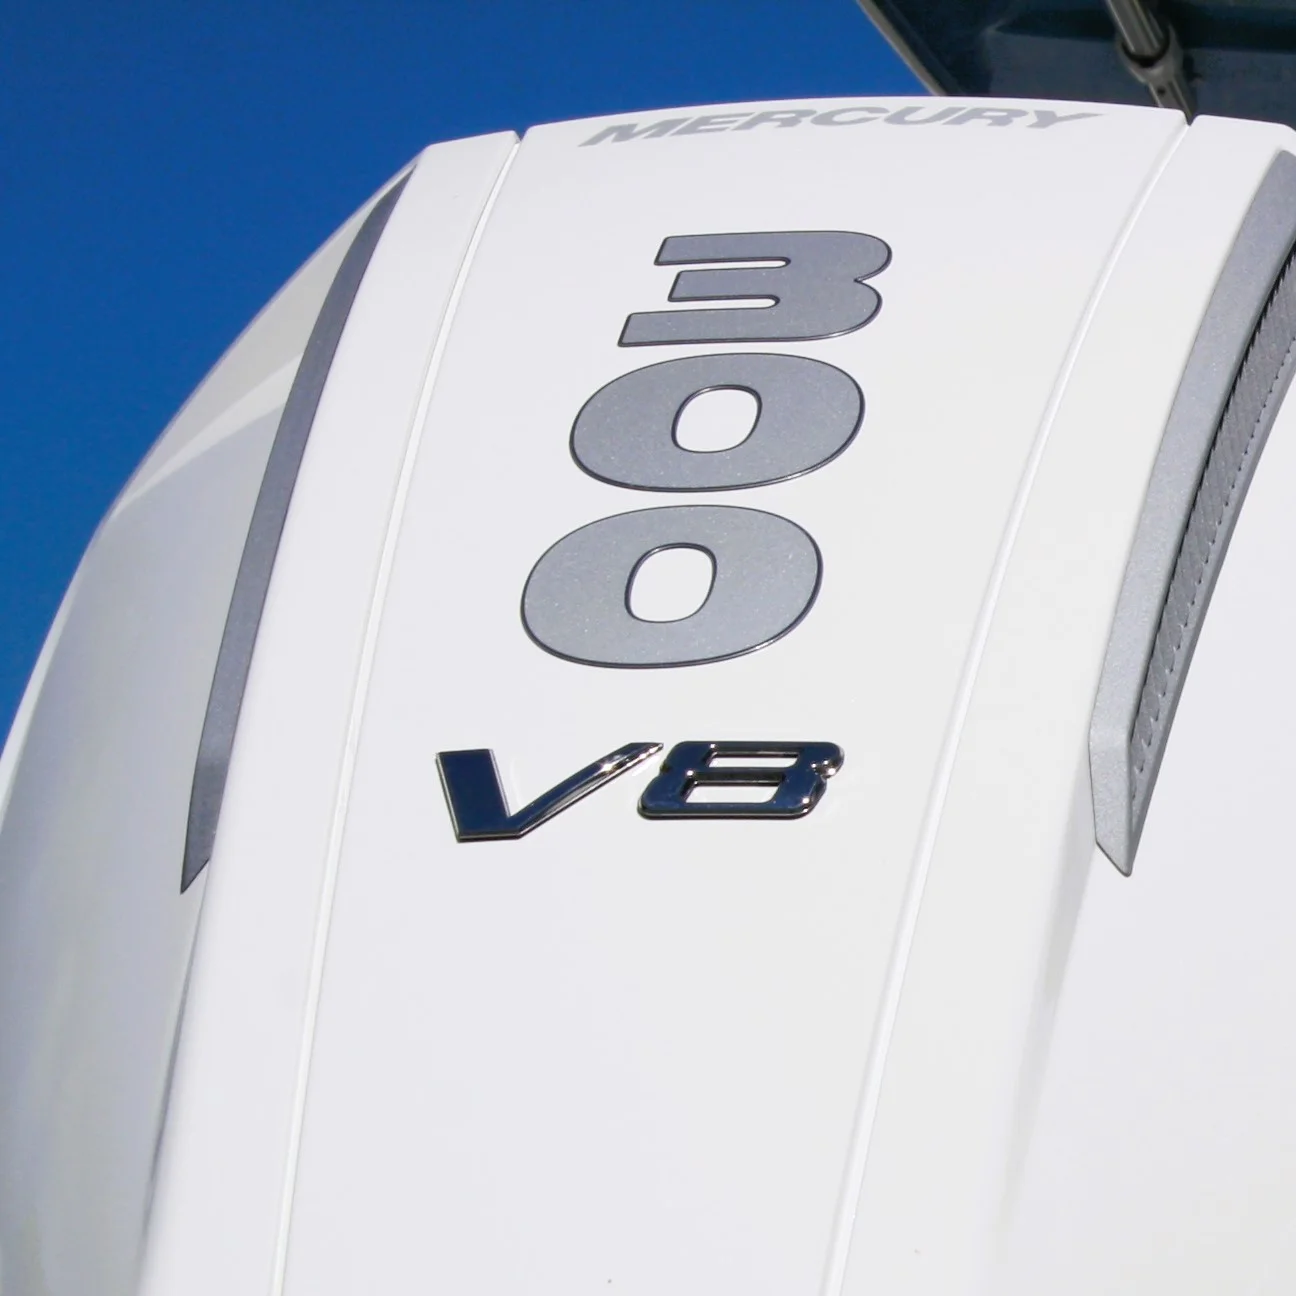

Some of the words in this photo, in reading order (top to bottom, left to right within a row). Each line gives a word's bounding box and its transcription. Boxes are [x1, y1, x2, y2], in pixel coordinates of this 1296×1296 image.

[578, 106, 1102, 147] MERCURY
[520, 230, 892, 669] 300
[434, 740, 845, 842] V8
